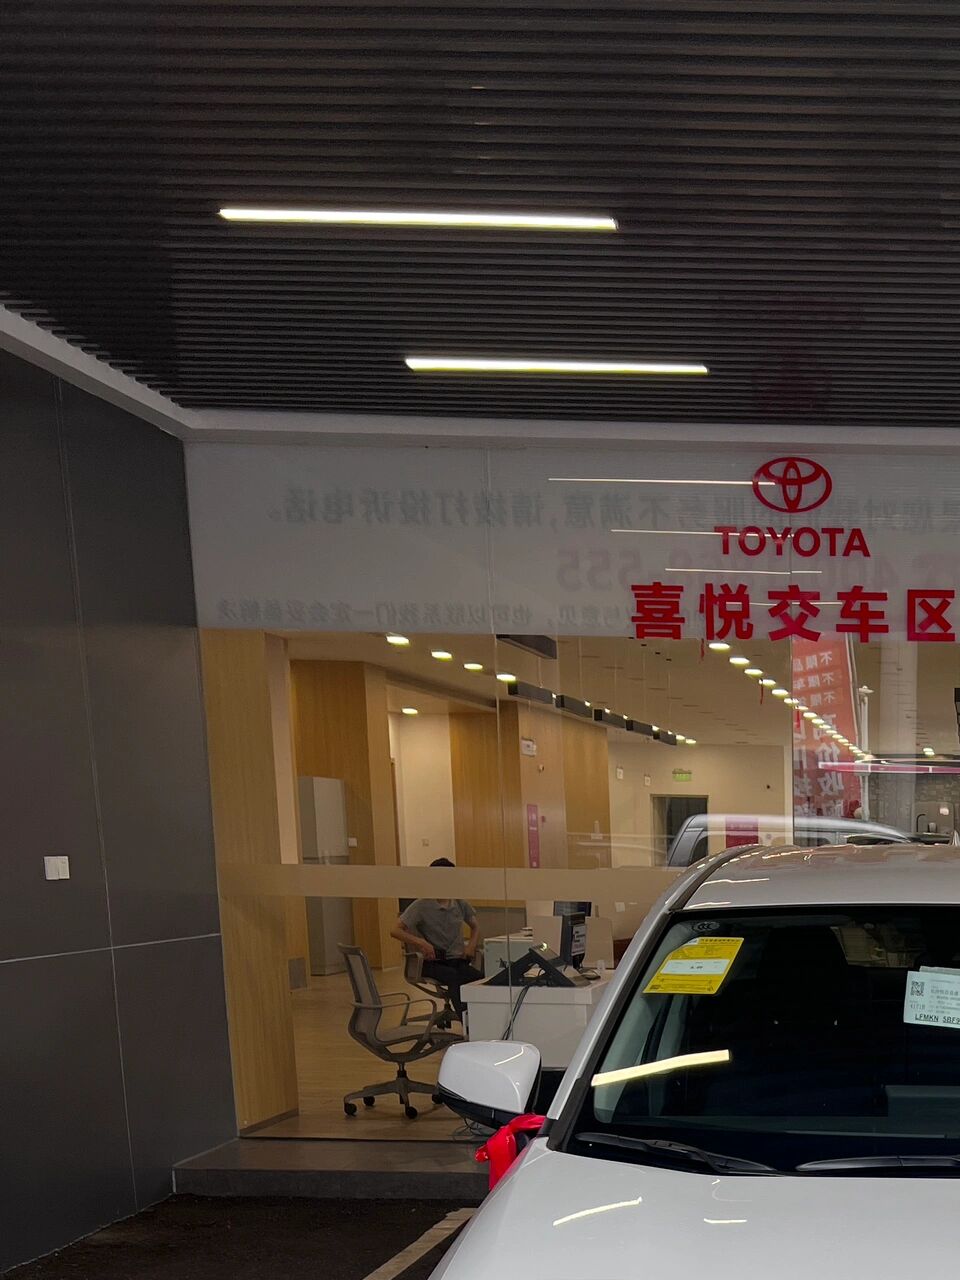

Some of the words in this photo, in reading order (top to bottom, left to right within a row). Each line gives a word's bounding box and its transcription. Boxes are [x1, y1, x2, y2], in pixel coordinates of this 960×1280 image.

[714, 526, 871, 558] TOYOTA
[630, 581, 957, 643] 喜悦交车区
